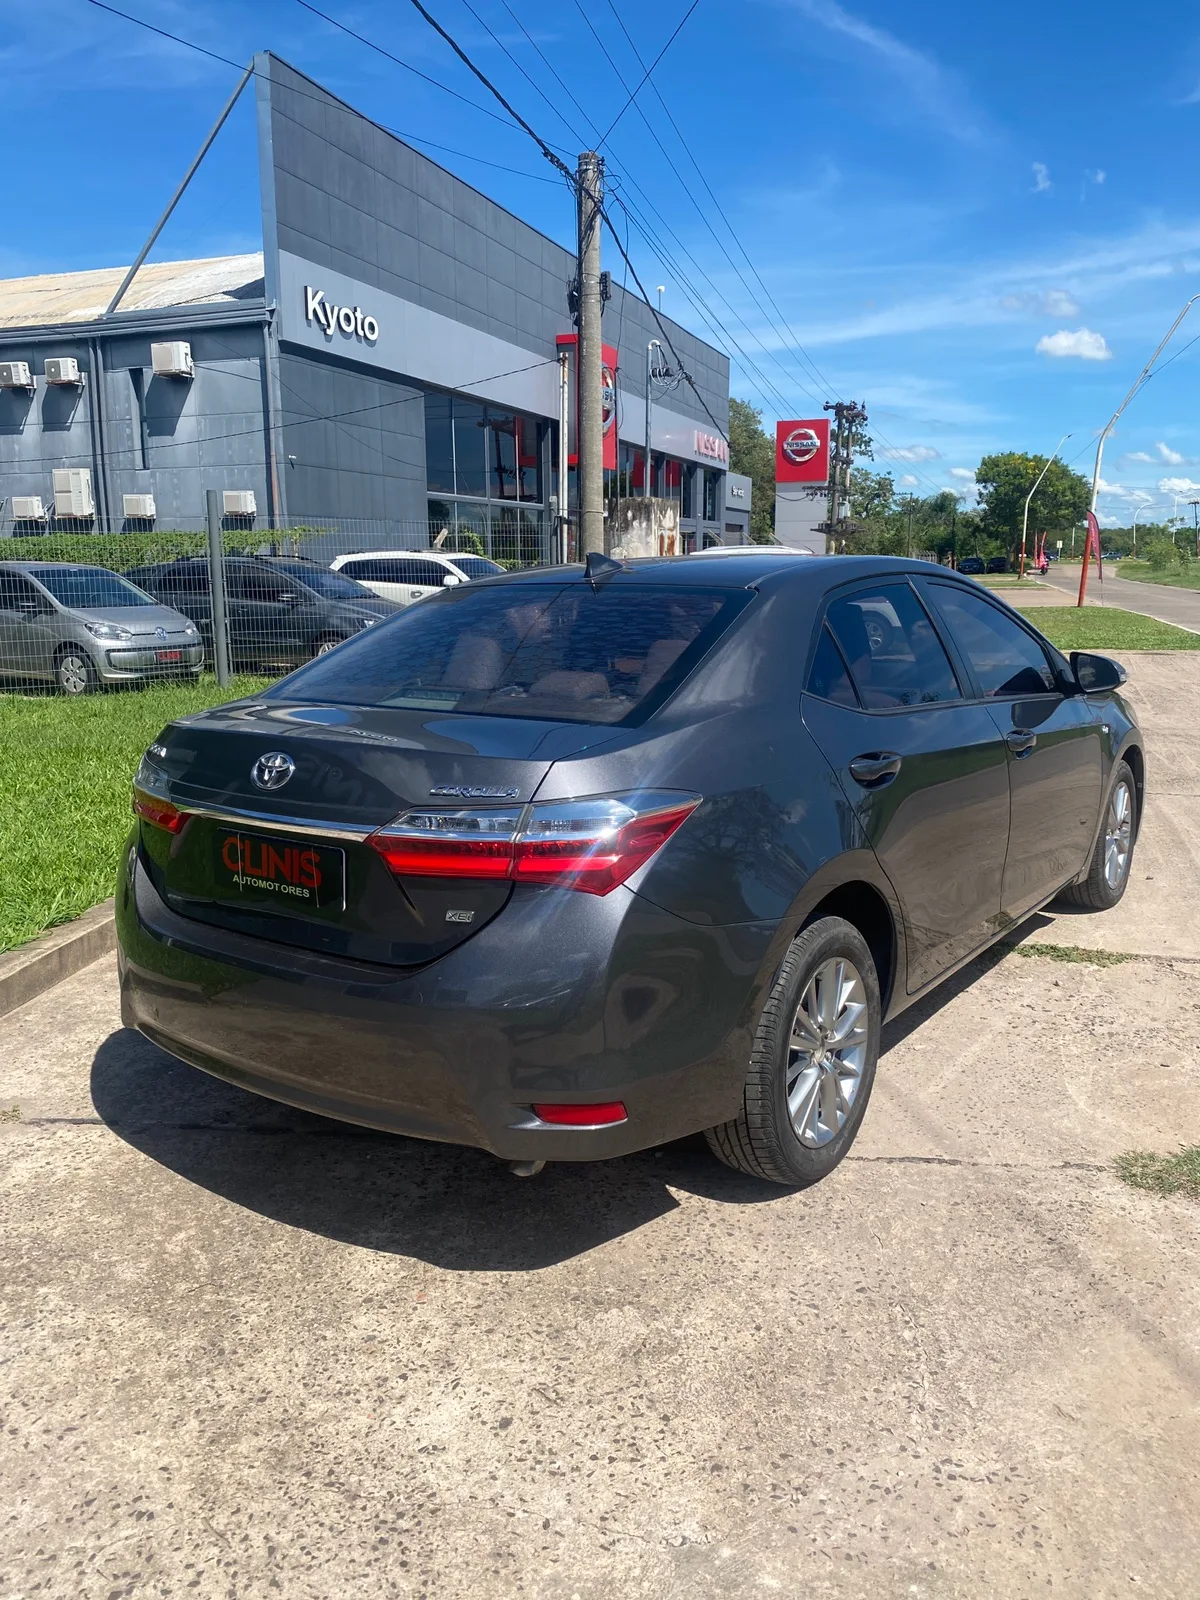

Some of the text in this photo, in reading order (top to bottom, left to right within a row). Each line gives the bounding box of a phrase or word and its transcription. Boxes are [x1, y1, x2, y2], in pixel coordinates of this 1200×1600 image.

[303, 285, 379, 341] Kyoto
[694, 429, 728, 460] NISSAN
[429, 784, 520, 799] COROLLA
[221, 835, 322, 889] CLINIS
[232, 873, 311, 898] AUTOMOTORES
